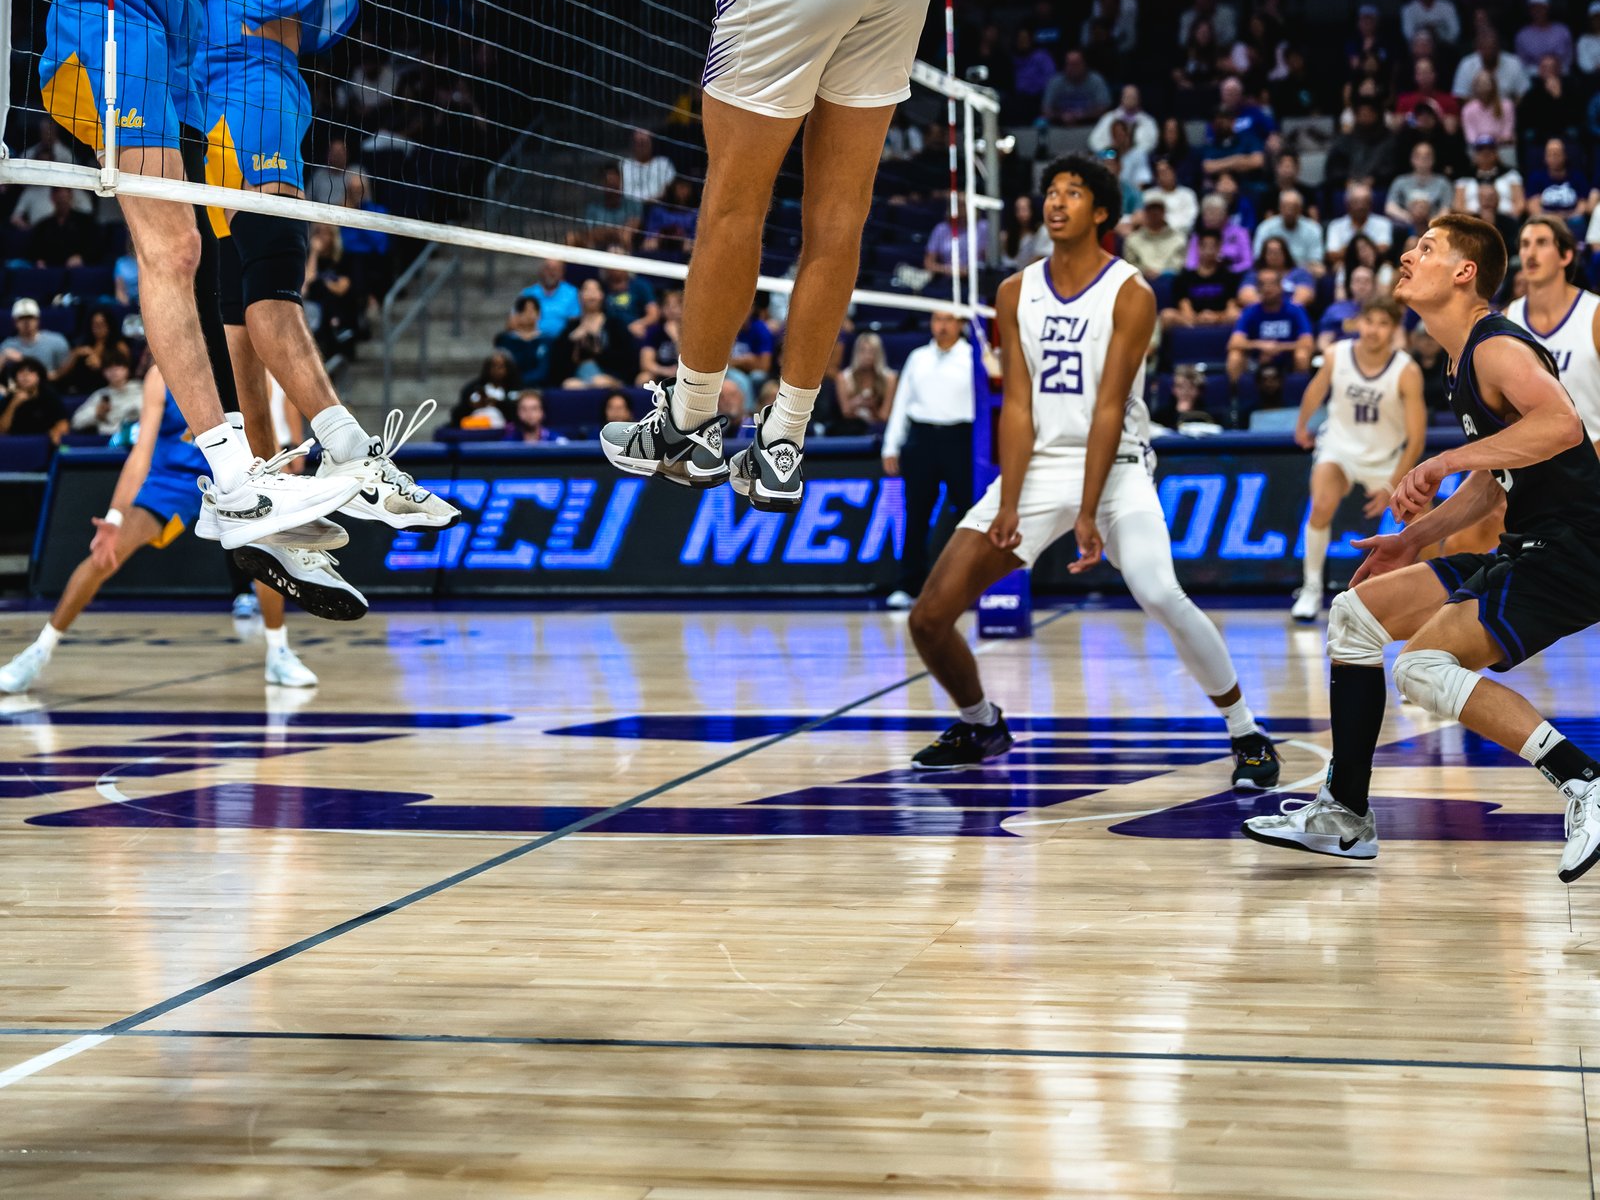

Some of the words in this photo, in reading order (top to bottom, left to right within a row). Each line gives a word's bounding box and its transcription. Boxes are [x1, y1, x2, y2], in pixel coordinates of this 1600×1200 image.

[1040, 306, 1089, 342] GCU
[1039, 349, 1083, 395] 23
[1354, 403, 1379, 424] 10
